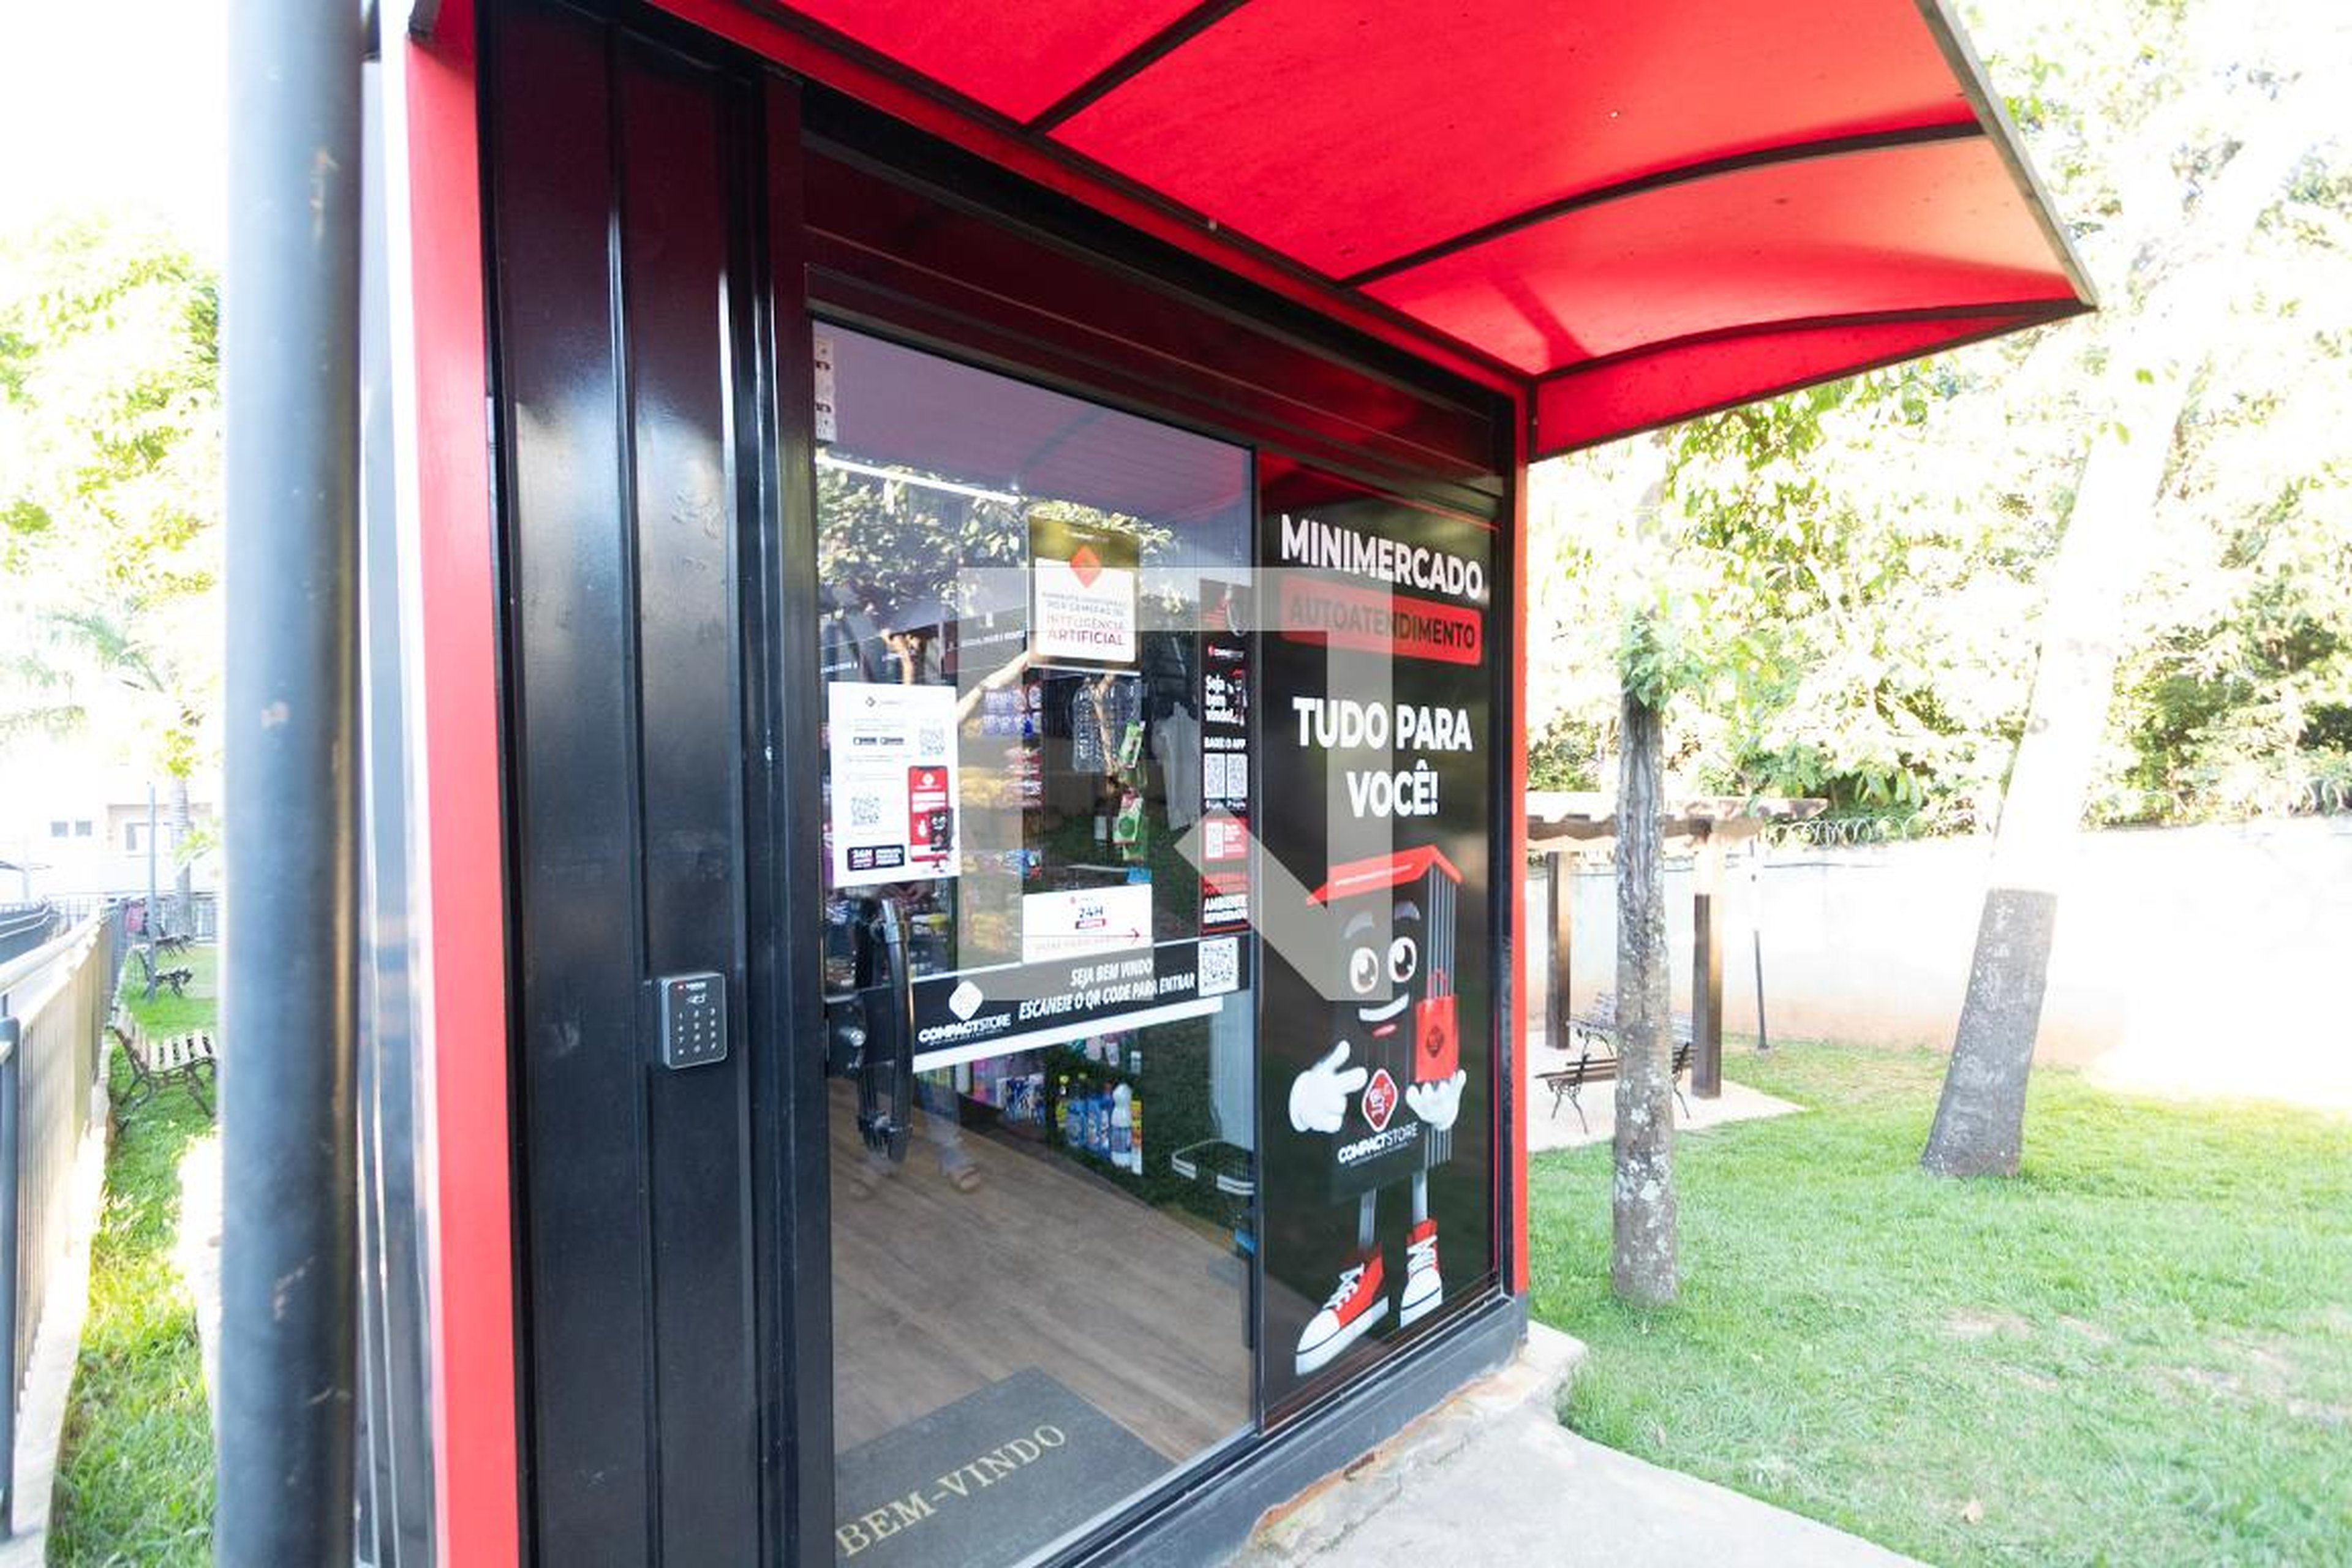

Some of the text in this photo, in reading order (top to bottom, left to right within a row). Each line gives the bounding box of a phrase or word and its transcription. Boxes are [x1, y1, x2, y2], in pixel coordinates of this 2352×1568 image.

[1281, 514, 1483, 600] MINIMERCADO
[1047, 628, 1126, 646] ARTIFICIAL
[1289, 595, 1476, 649] AUTOATENDIMENTO
[1292, 697, 1473, 752] TUDO PARA
[1346, 759, 1439, 818] VOCÊ!
[1018, 972, 1195, 1020] ESCANEIE O QR CODE PARA ENTRAR
[1070, 957, 1153, 990] SEJA BEM VINDO
[918, 1013, 1011, 1043] COMPACTSTORE
[1337, 1121, 1419, 1164] COMPACTSTORE
[834, 1424, 1066, 1558] BEM-VINDO
